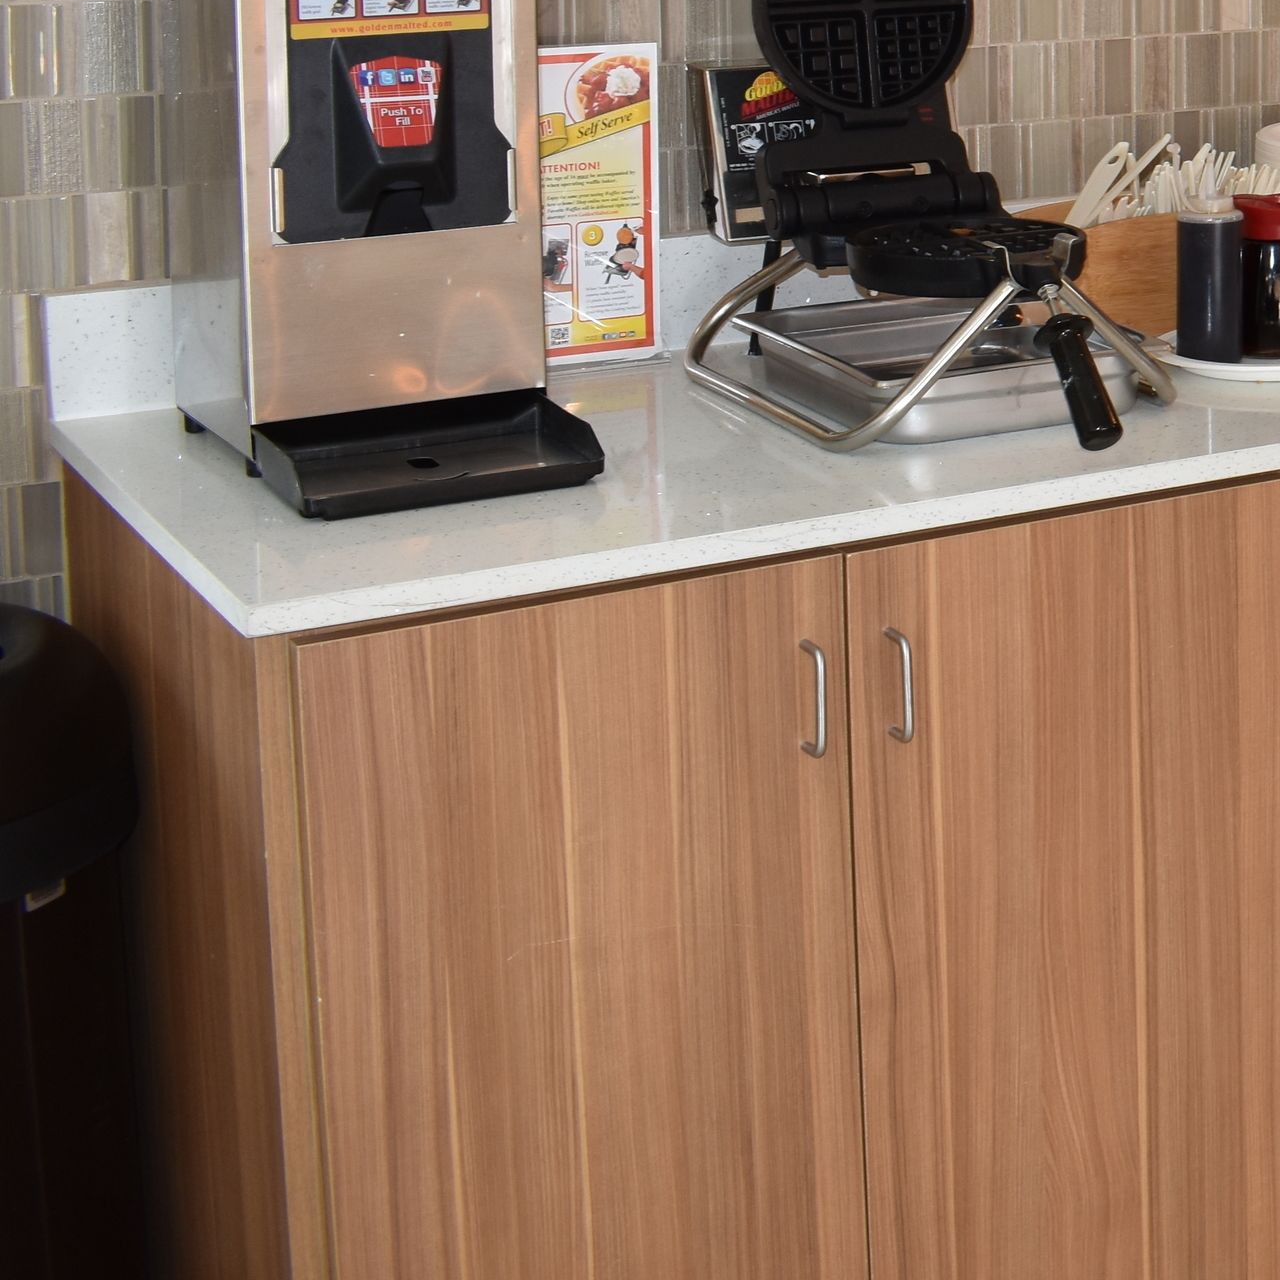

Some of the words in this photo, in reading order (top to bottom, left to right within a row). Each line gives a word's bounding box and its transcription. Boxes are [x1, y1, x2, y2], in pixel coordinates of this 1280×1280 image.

[330, 19, 453, 33] www.goldenmalted.com
[380, 107, 407, 116] Push
[409, 106, 424, 115] To
[395, 117, 411, 126] Fill
[576, 120, 600, 138] Self
[600, 112, 633, 130] Serve
